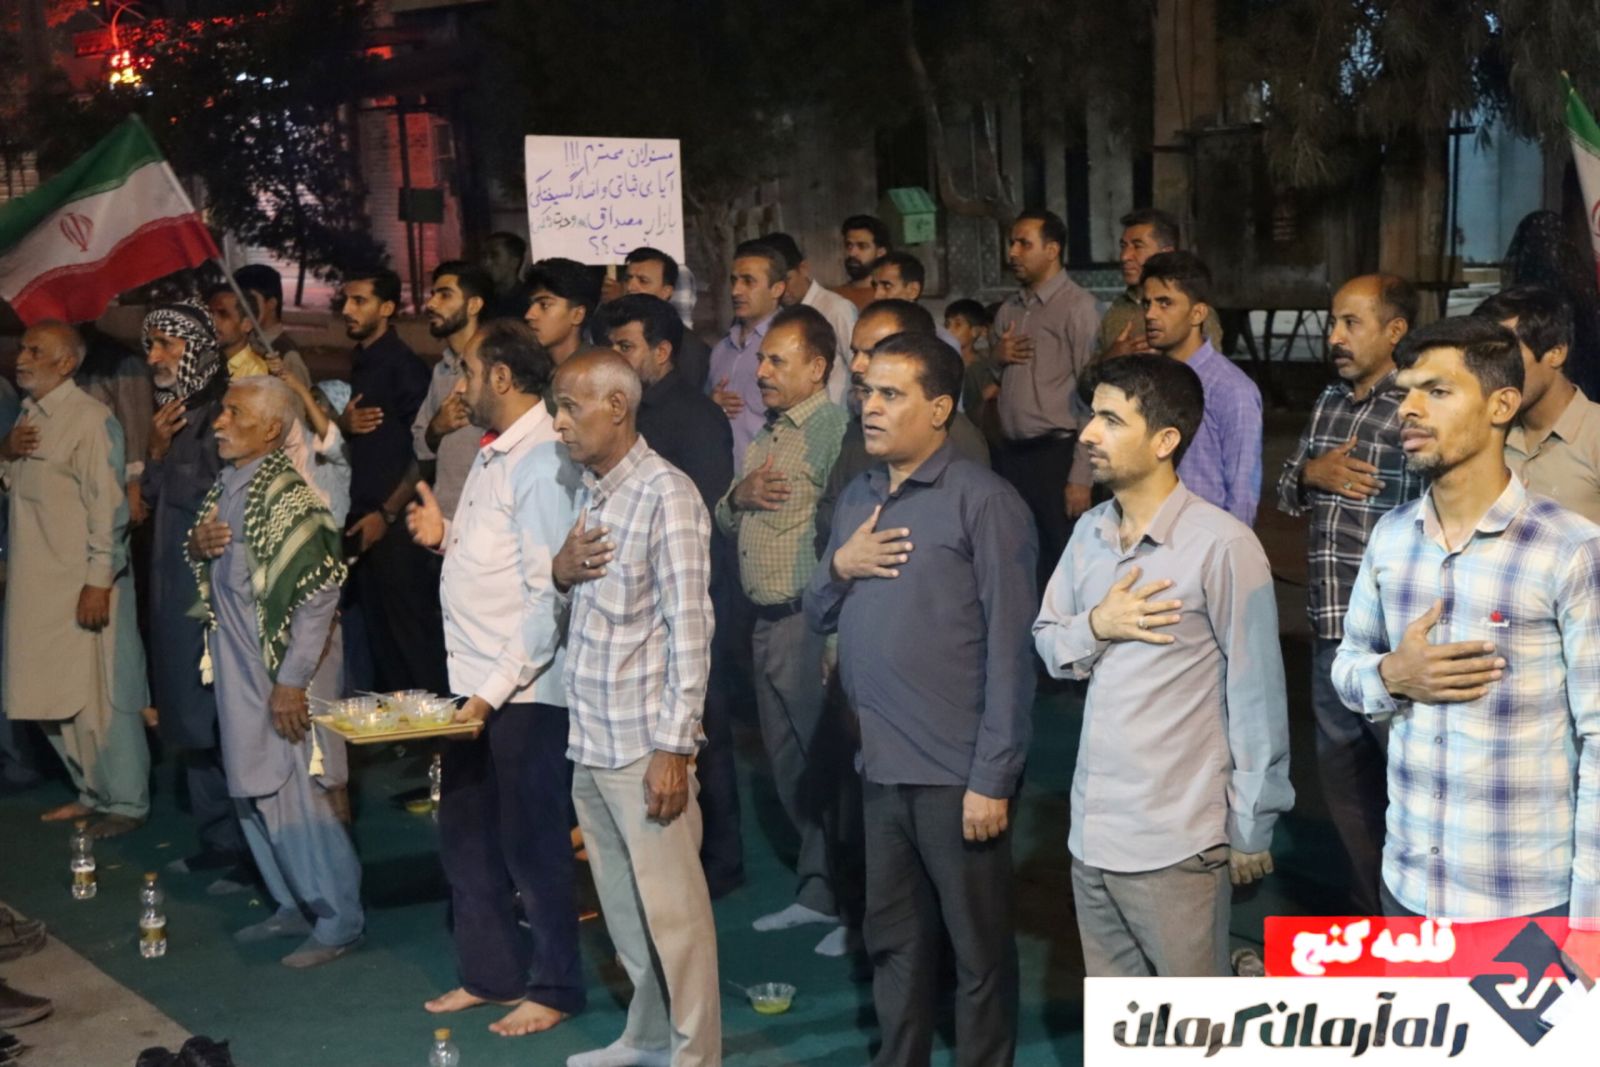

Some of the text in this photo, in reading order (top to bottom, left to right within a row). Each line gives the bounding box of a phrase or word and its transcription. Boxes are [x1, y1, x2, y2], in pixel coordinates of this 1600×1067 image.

[585, 143, 624, 175] محترم
[658, 169, 675, 198] آیا
[587, 205, 643, 231] مصداق
[644, 202, 677, 235] بازار
